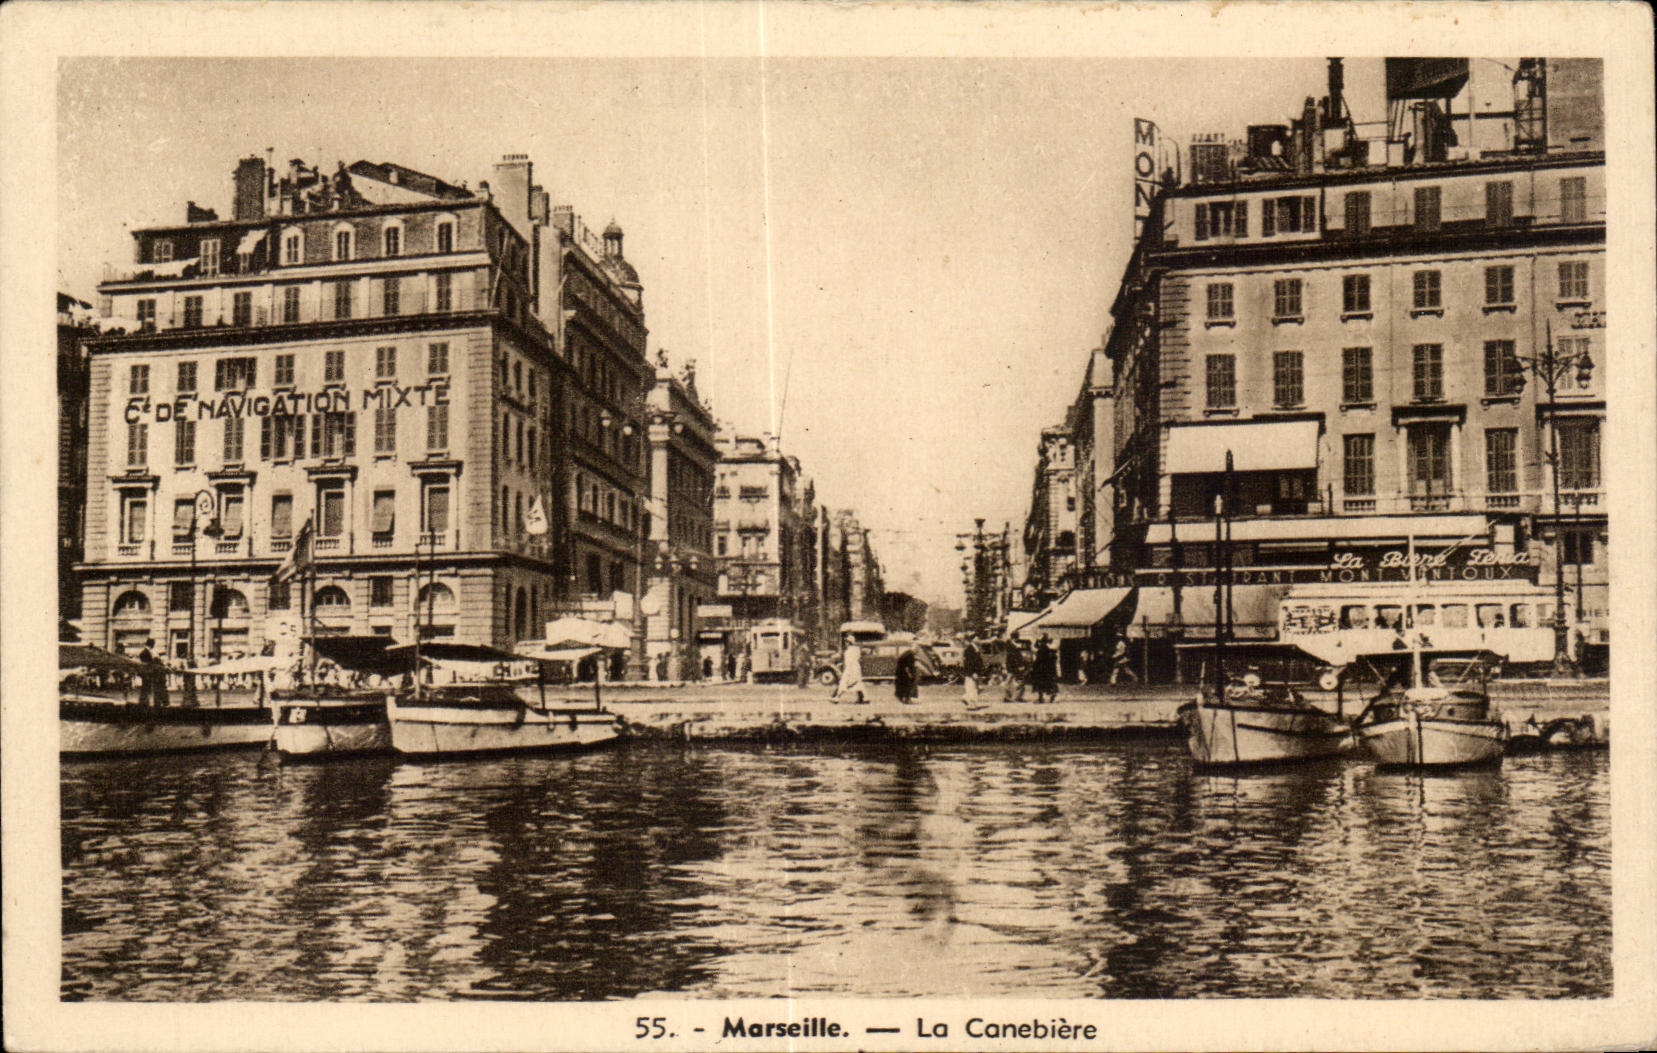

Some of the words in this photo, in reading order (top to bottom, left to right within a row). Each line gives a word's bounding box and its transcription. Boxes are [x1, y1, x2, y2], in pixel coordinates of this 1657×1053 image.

[156, 402, 188, 422] DE
[198, 390, 350, 420] NAVIGATION
[363, 384, 451, 410] MIXTE
[1330, 552, 1364, 569] La
[1319, 568, 1383, 583] MONT
[1400, 566, 1512, 583] VNTOUX
